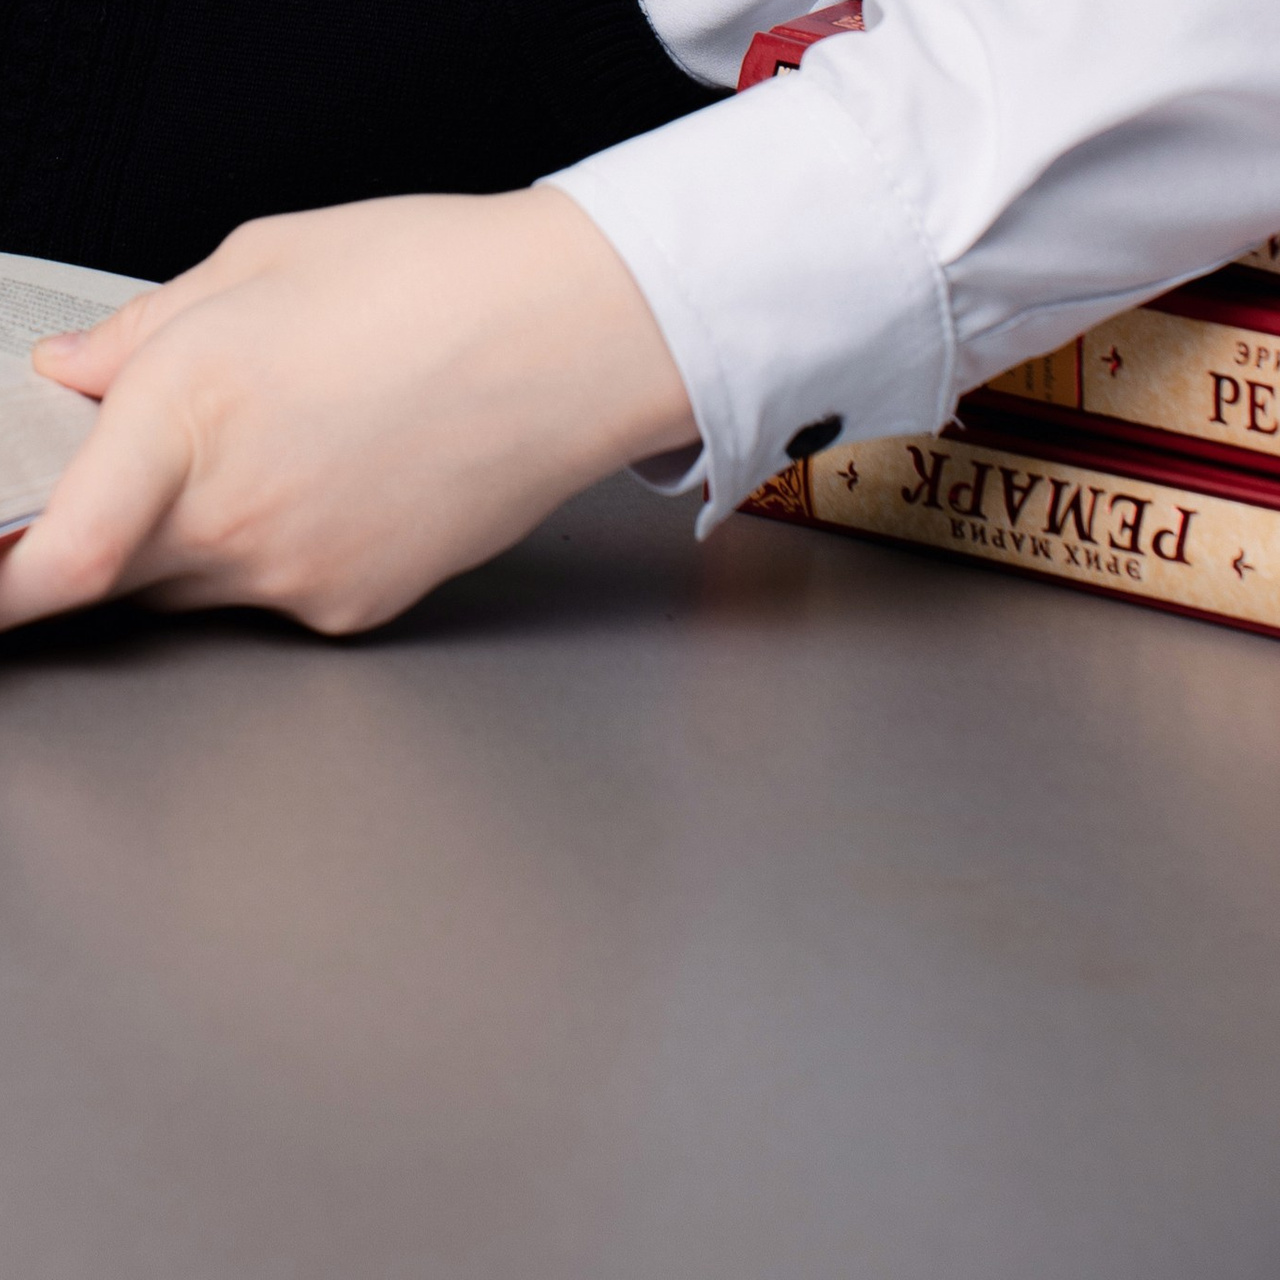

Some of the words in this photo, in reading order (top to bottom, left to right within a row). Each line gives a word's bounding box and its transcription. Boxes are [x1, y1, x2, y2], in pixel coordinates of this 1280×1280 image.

[901, 445, 1199, 566] РЕМАРК
[948, 516, 1052, 559] МАРИЯ
[1063, 541, 1143, 581] ЭРИХ
